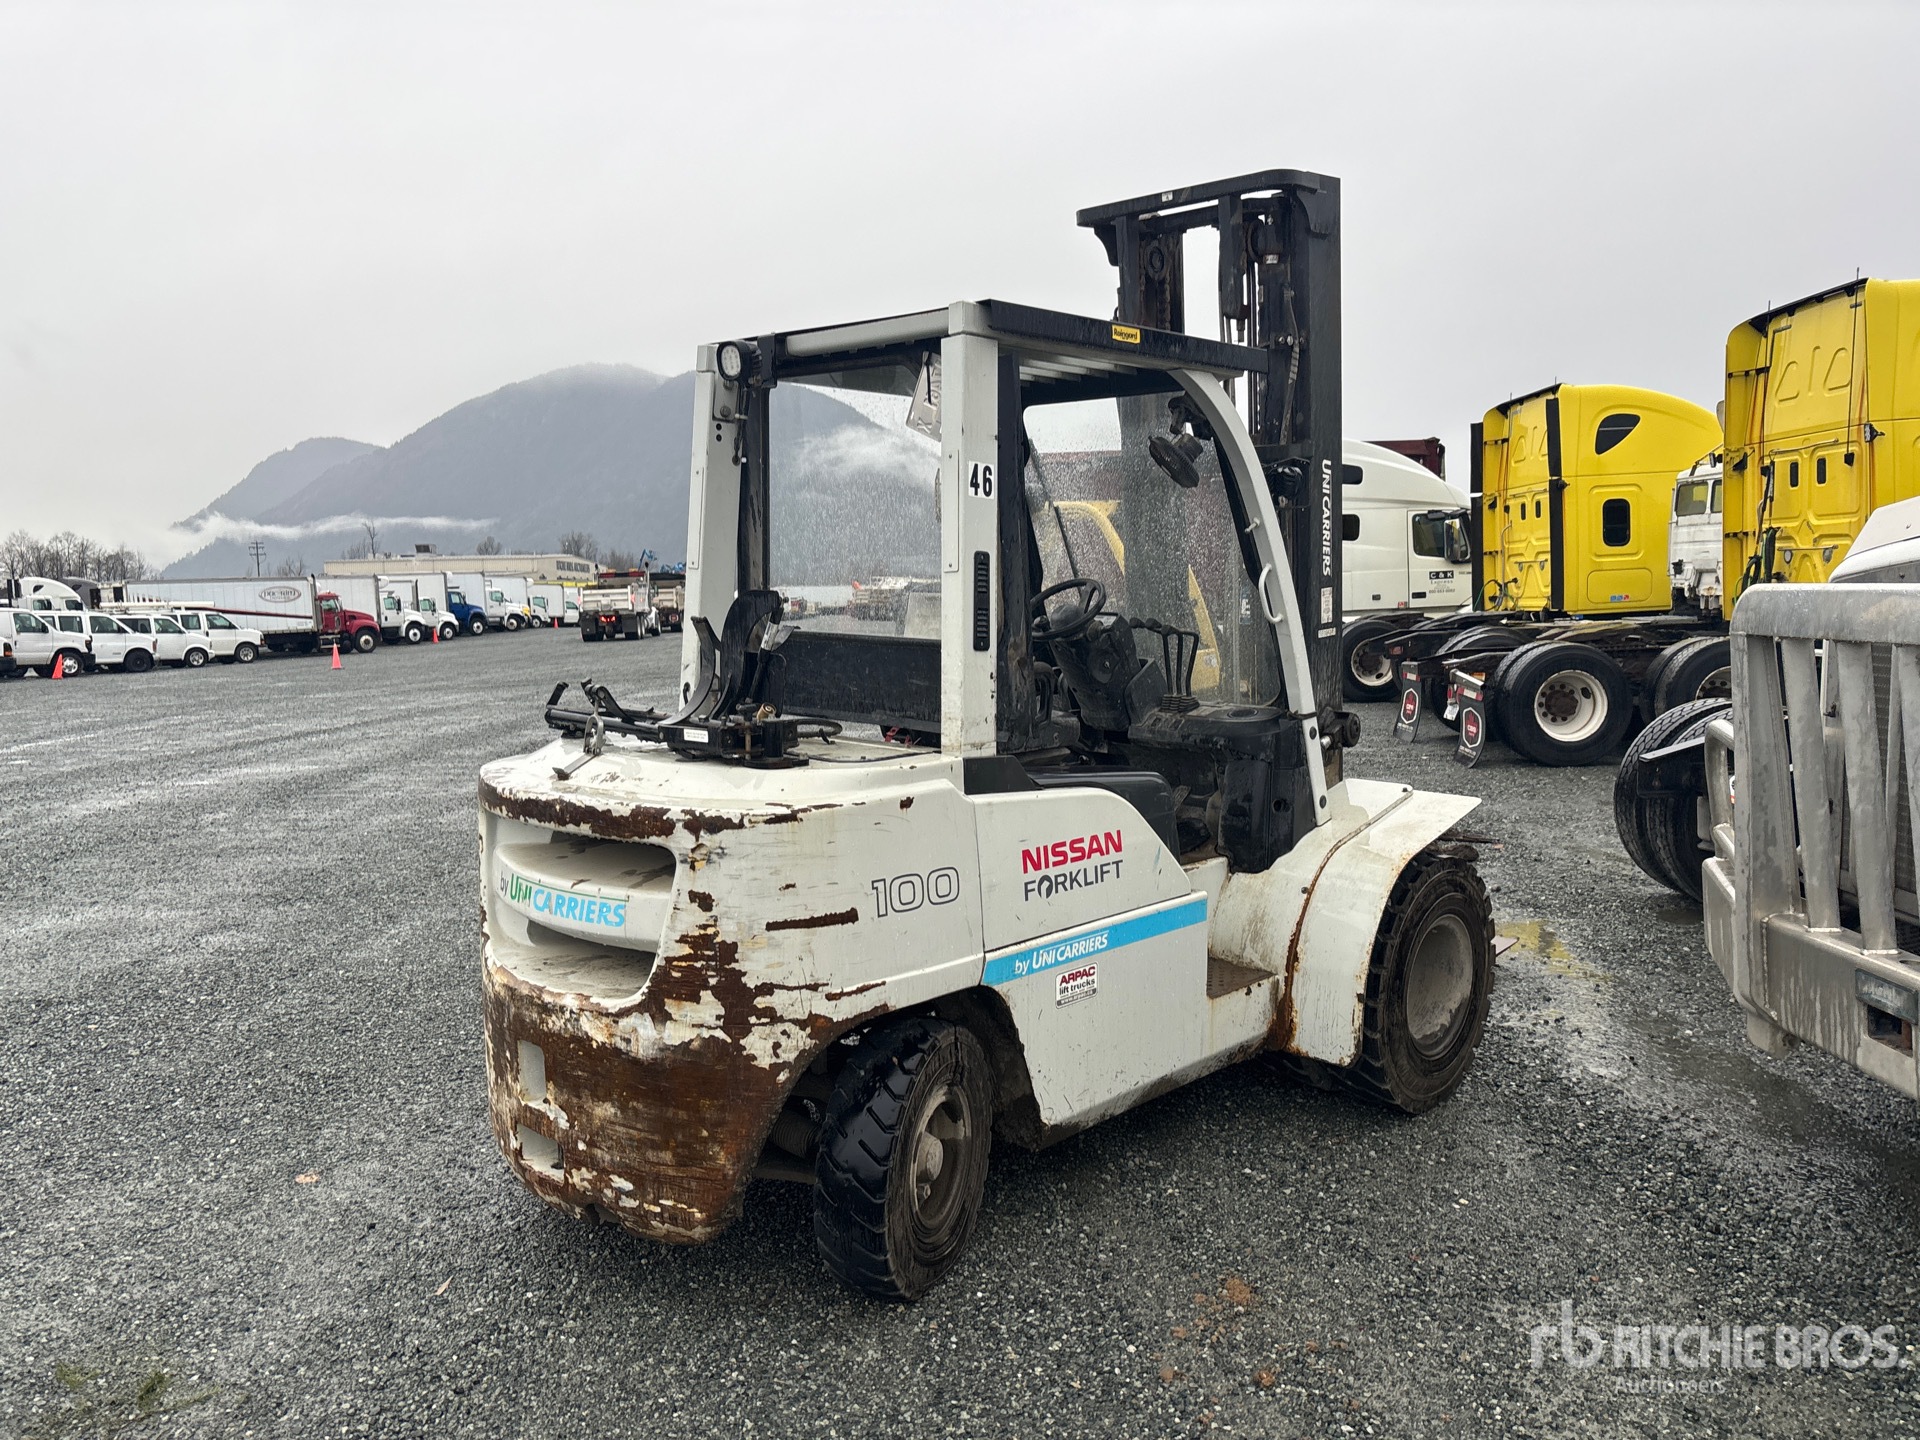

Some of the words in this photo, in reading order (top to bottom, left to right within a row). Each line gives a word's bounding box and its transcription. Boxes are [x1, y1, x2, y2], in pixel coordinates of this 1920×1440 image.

[970, 463, 993, 497] 46
[1022, 830, 1122, 874] NISSAN
[500, 872, 509, 897] by
[871, 866, 960, 918] 100
[1023, 860, 1123, 901] FORKLIFT
[1014, 959, 1030, 975] by
[1059, 966, 1096, 986] ARPAC
[1059, 986, 1069, 995] lift
[1070, 979, 1096, 992] trucks
